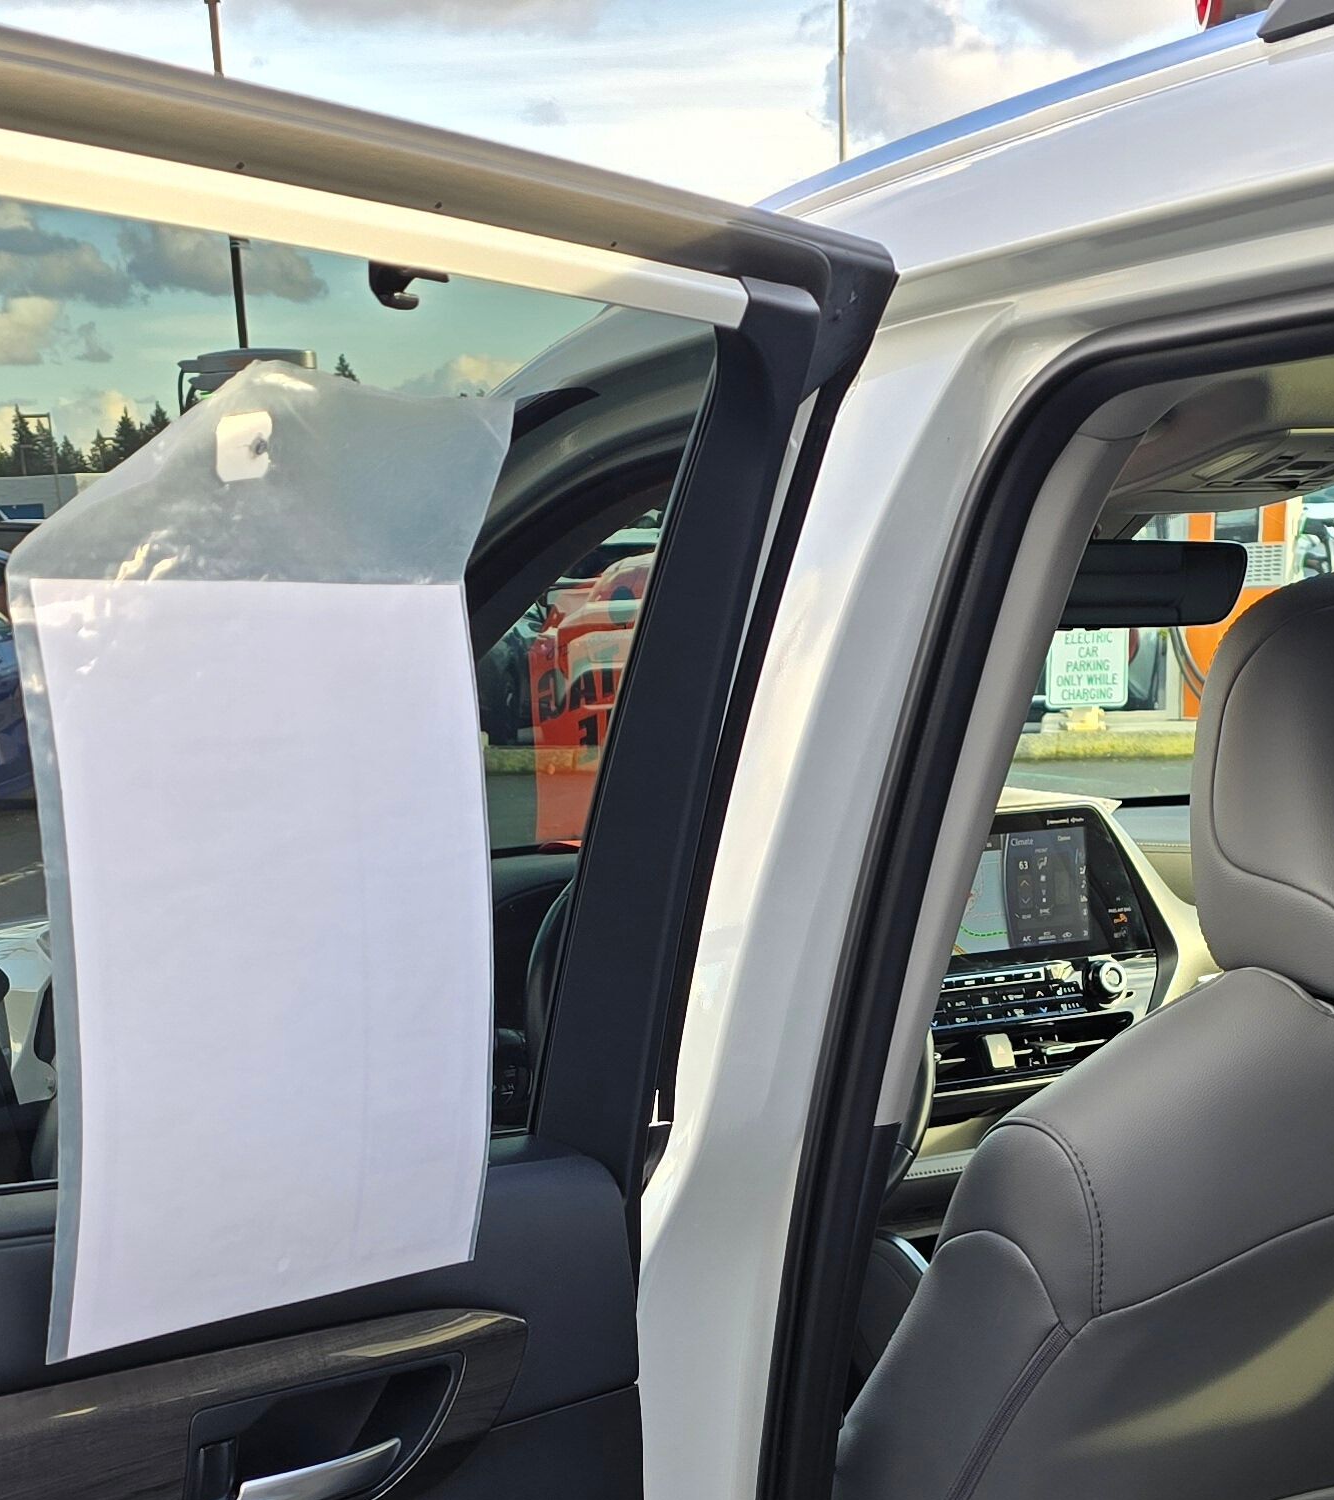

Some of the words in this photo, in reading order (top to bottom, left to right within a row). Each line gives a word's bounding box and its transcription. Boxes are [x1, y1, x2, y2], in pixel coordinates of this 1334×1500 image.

[1064, 631, 1113, 645] ELECTRIC
[1078, 646, 1099, 658] CAR
[1066, 659, 1111, 673] PARKING
[1056, 674, 1083, 687] ONLY
[1087, 673, 1118, 686] WHILE
[1061, 688, 1114, 702] CHARGING
[1019, 860, 1029, 870] 63
